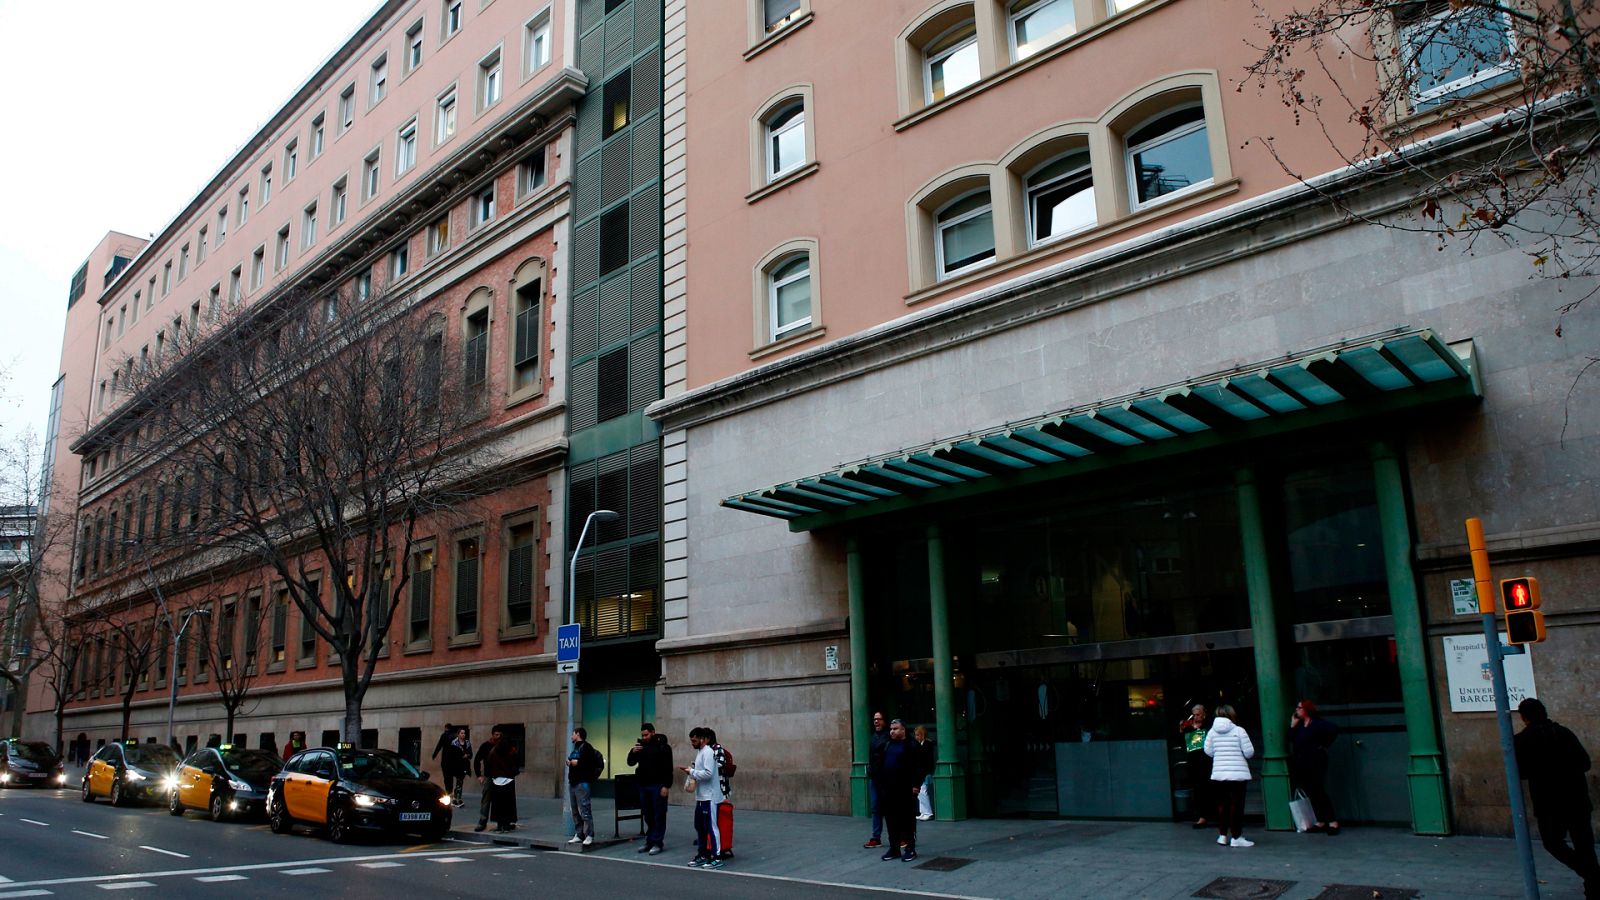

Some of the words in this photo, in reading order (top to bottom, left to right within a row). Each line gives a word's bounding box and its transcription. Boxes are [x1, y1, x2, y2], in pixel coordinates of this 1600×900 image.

[559, 636, 578, 648] TAXI
[1453, 643, 1480, 652] Hospital
[1459, 686, 1518, 695] UNIVERAT
[1460, 693, 1526, 703] BARCENA
